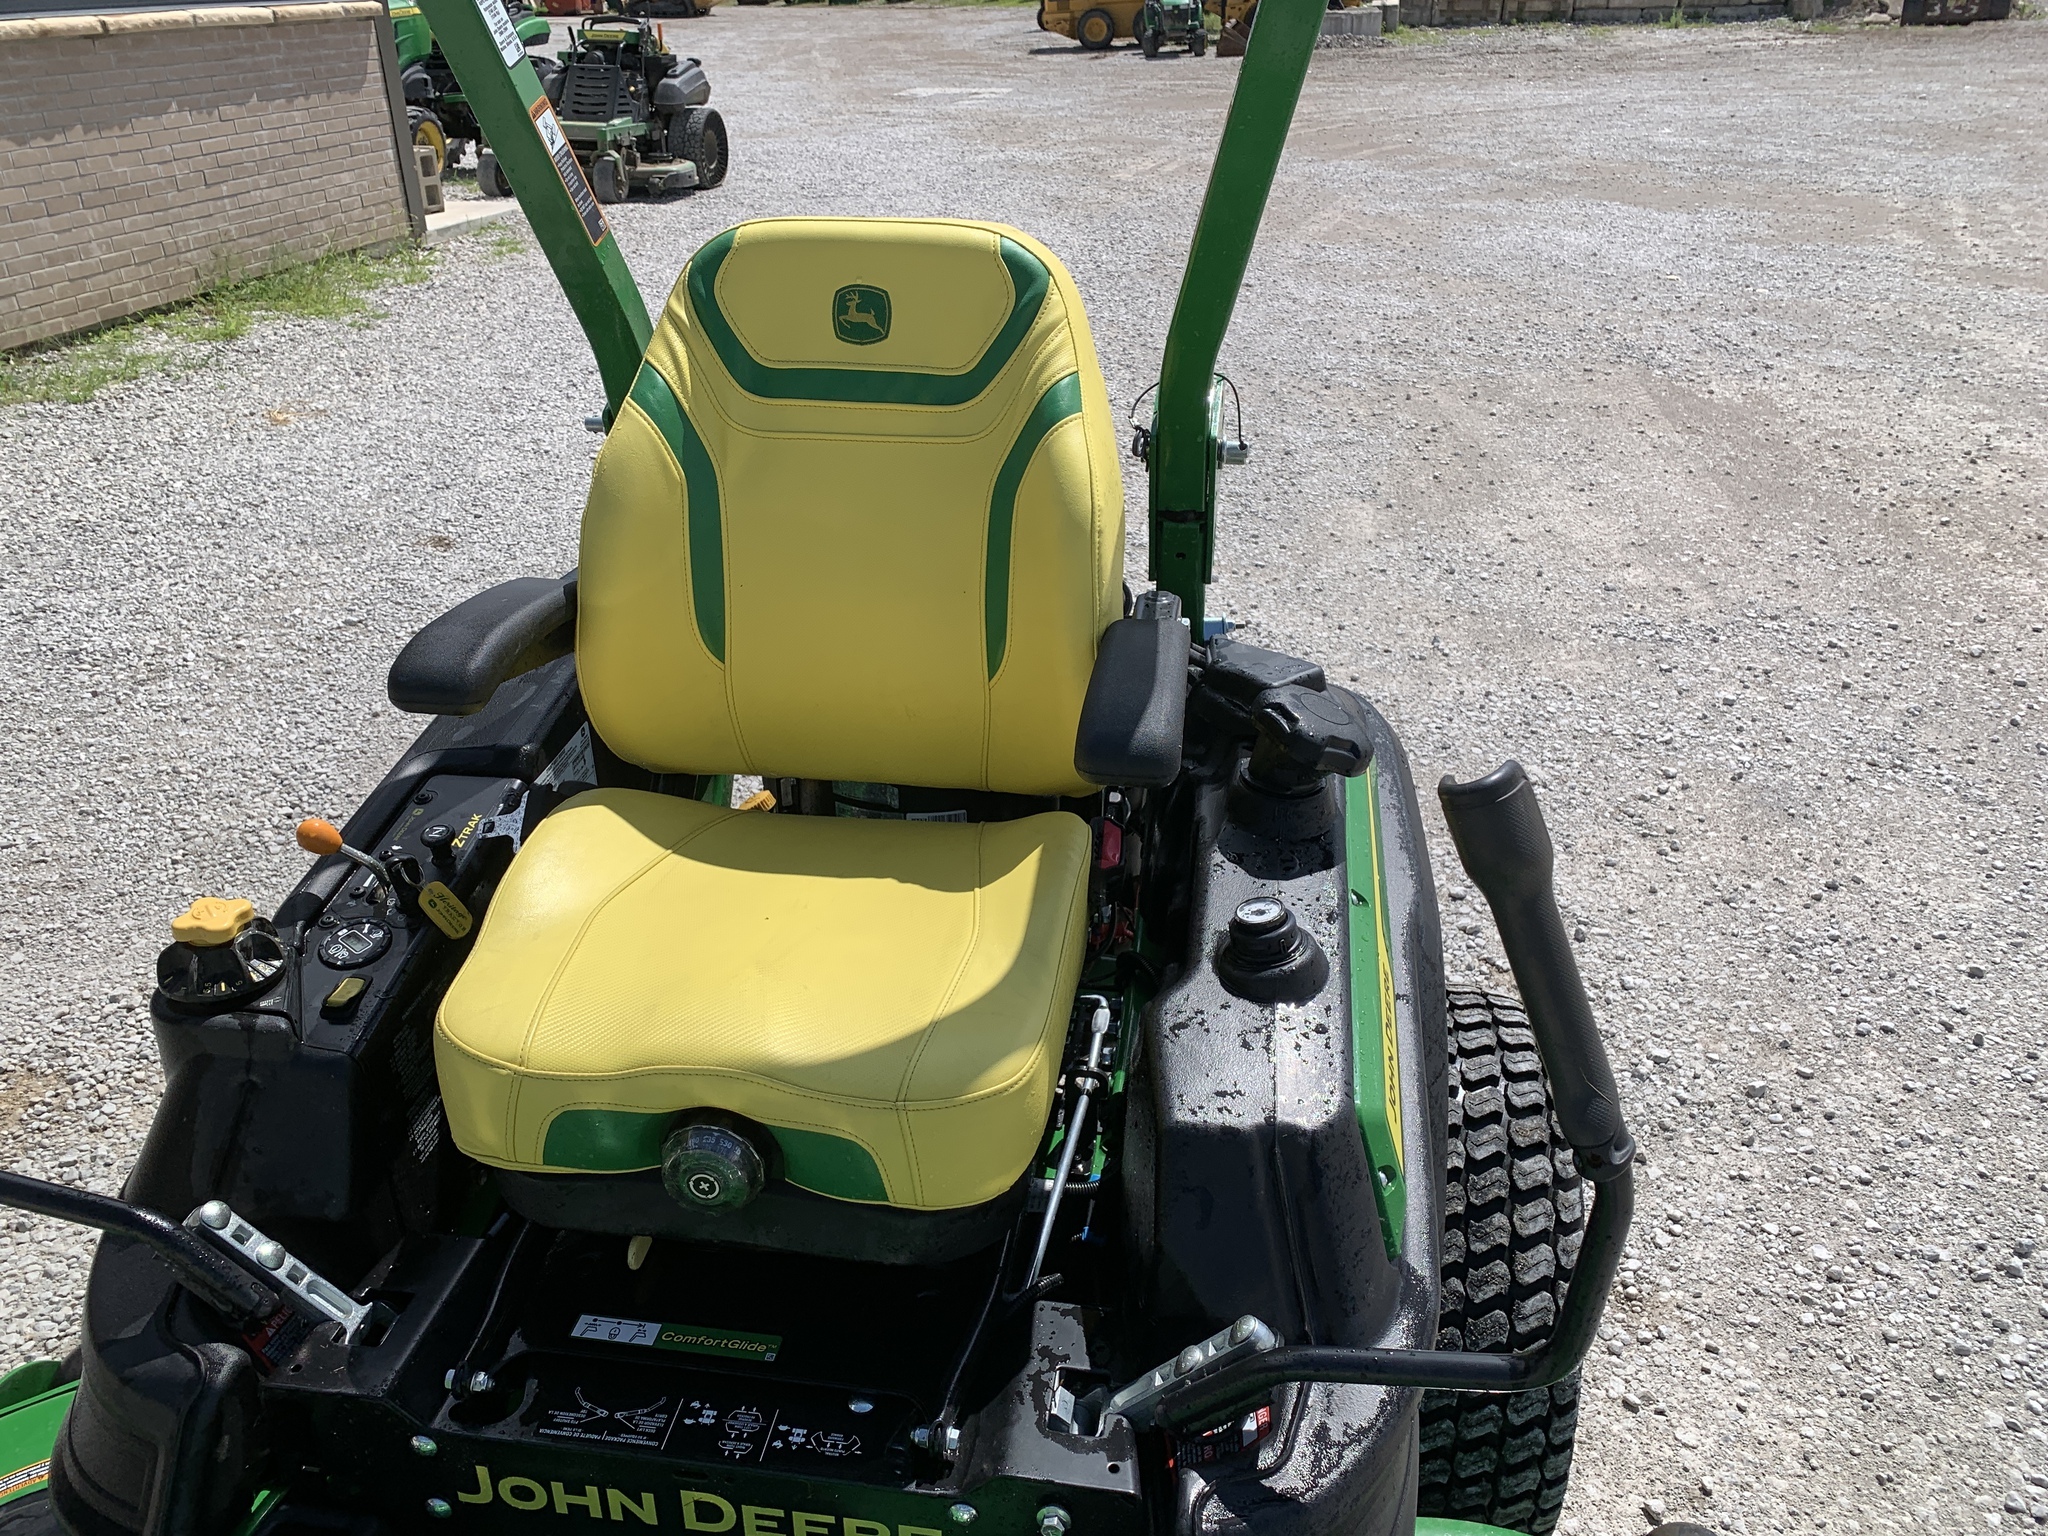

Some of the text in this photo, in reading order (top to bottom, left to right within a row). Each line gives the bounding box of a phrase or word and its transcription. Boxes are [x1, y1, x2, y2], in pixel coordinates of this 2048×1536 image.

[451, 813, 483, 848] ZTRAK
[432, 892, 468, 920] Heritage
[1382, 962, 1397, 1124] JOHN DEERE
[458, 1466, 658, 1525] JOHN
